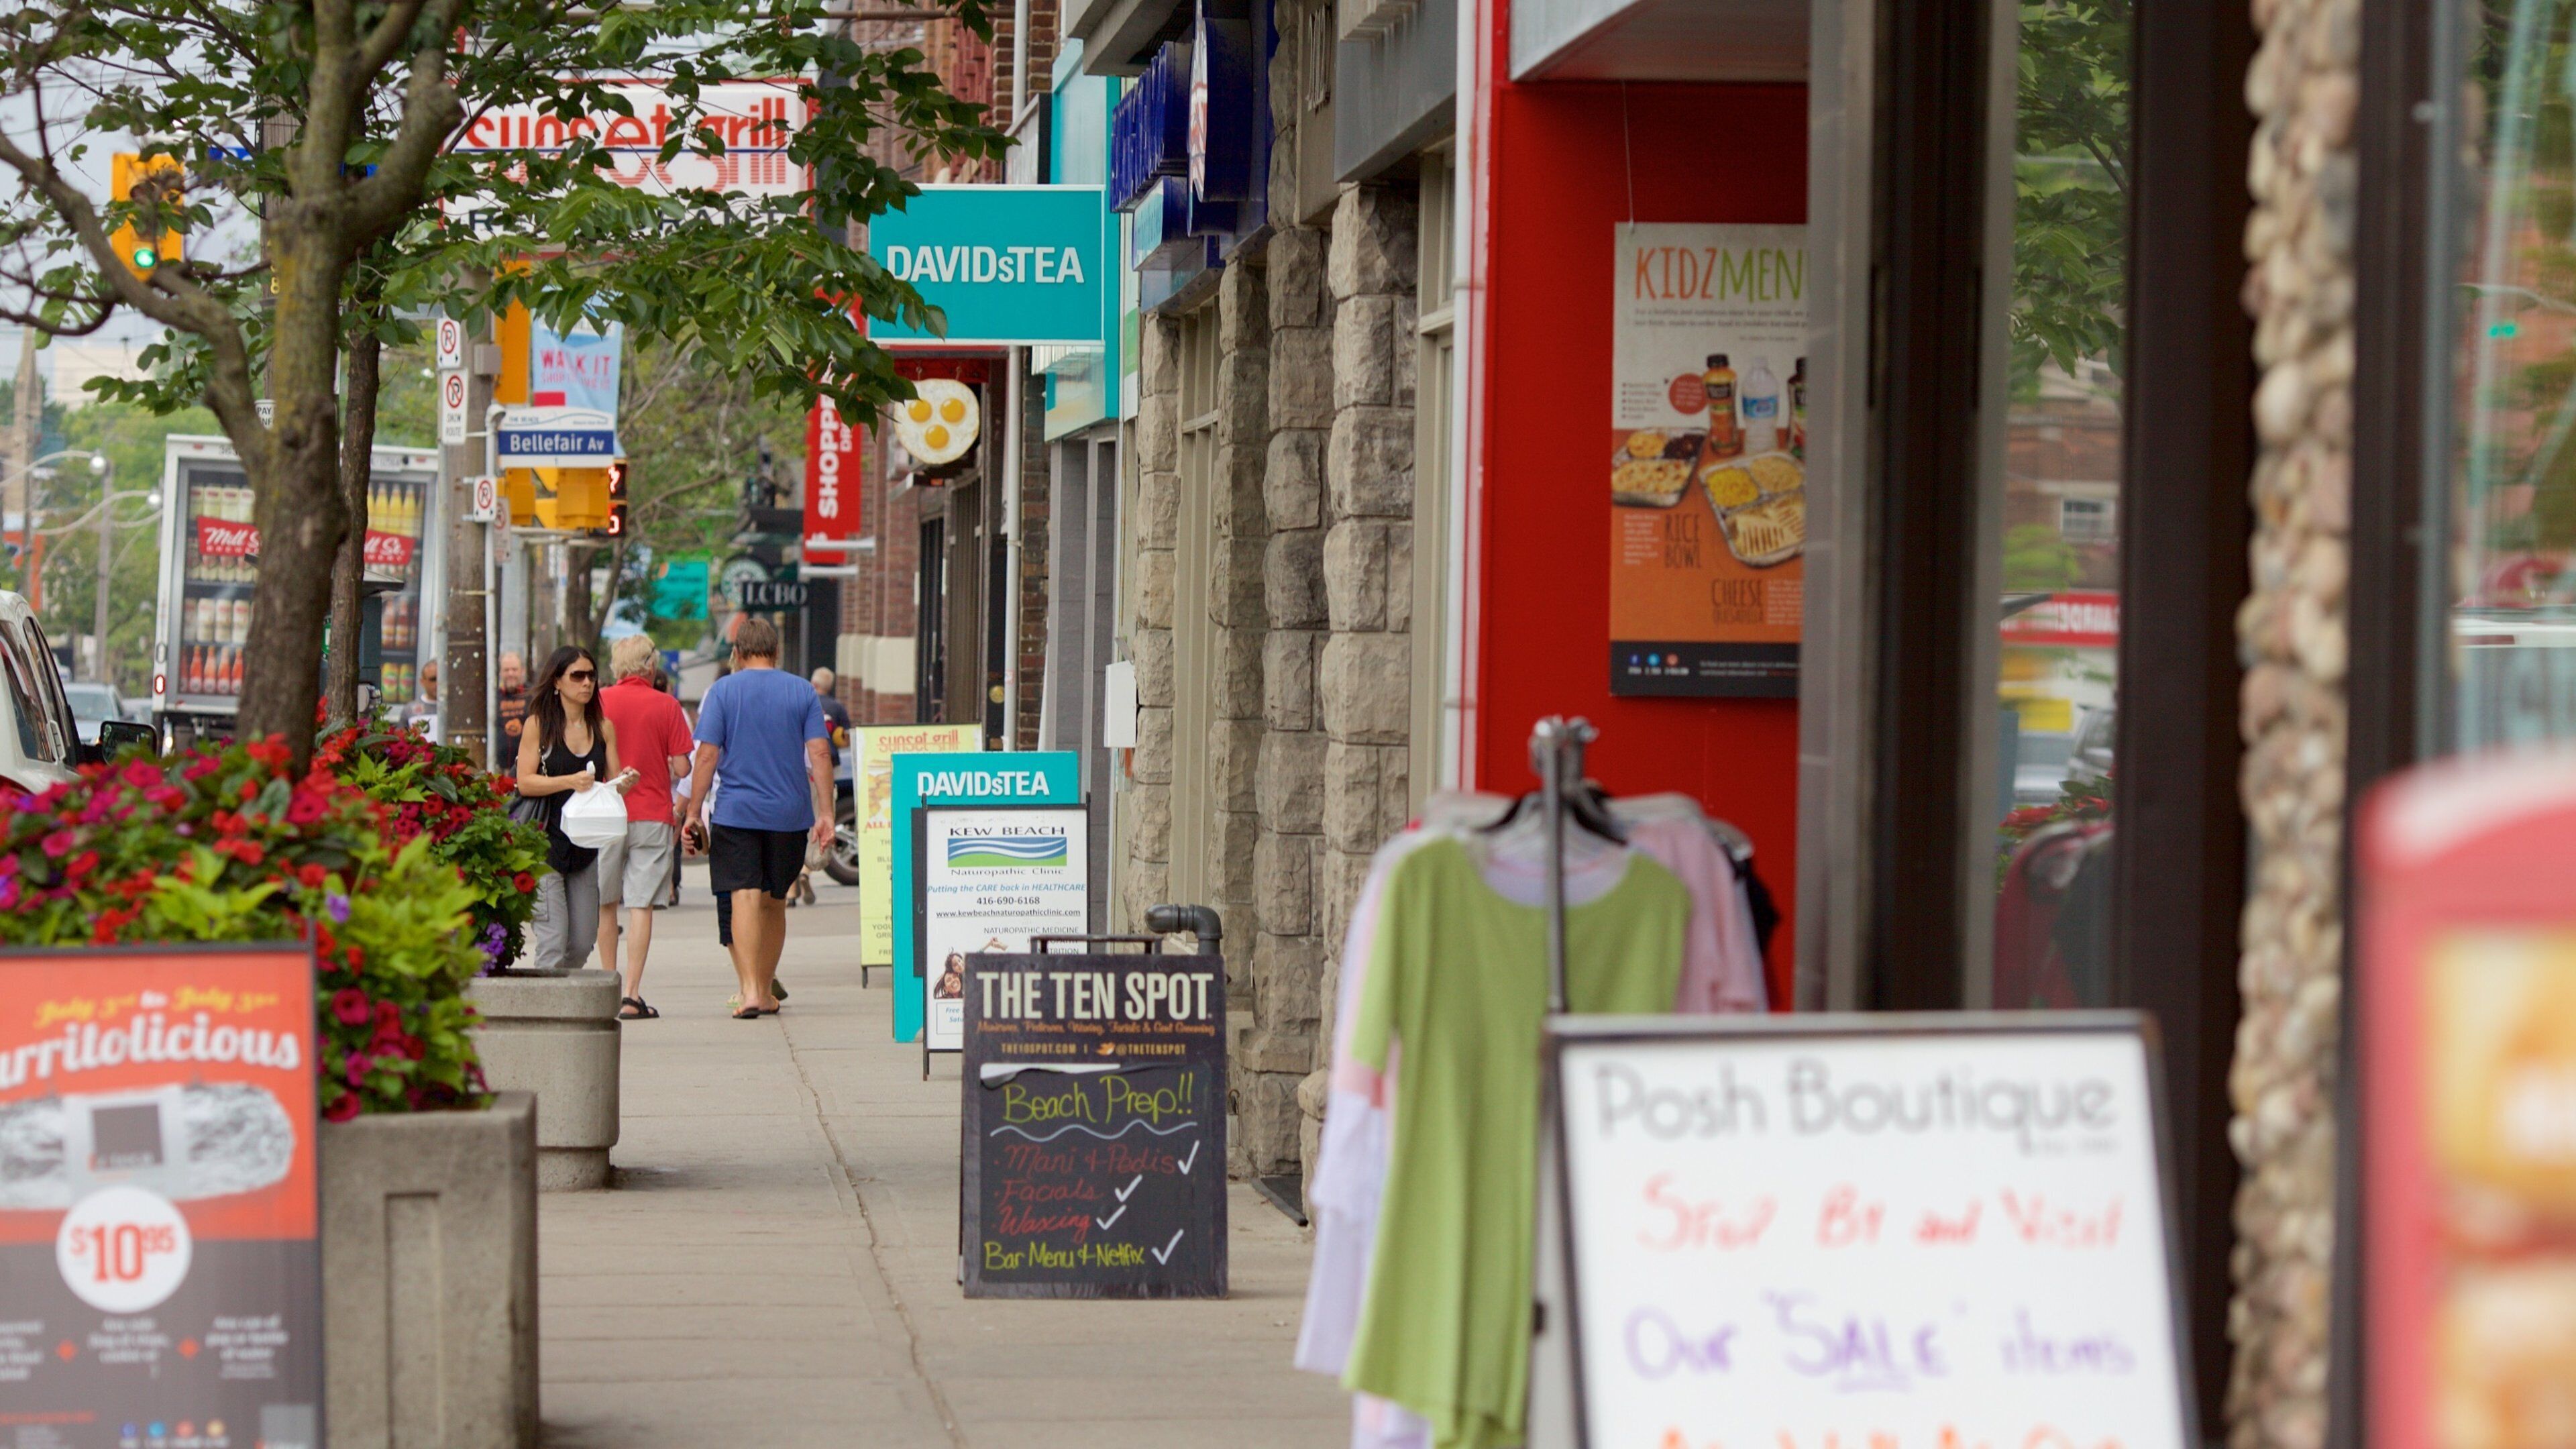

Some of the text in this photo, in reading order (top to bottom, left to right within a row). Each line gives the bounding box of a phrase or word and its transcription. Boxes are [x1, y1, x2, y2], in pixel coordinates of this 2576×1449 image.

[467, 97, 786, 148] sunset grill
[887, 245, 1085, 284] DAVIDsTEA
[257, 407, 272, 415] PAY
[510, 433, 604, 452] Bellefair Av
[818, 366, 839, 519] SHOPPE
[746, 582, 807, 605] LCBO
[879, 729, 959, 746] sunset grill
[917, 771, 1050, 797] DAVIDsTEA
[950, 826, 1065, 837] KEW BEACH
[951, 867, 1064, 877] Naturopathic Clinic
[927, 885, 957, 894] Putting
[960, 884, 973, 892] the
[1000, 883, 1020, 892] back
[1031, 883, 1086, 892] HEALTHCARE
[976, 896, 1040, 905] 416-690-6168
[936, 908, 1081, 918] www.kewbeachnaturopathicclinic.com
[976, 972, 1214, 1020] THE TEN SPOT
[1003, 1071, 1193, 1124] Beach Prep!!
[1594, 1056, 2118, 1156] Posh Boutique
[1004, 1144, 1077, 1178] Mani
[998, 1205, 1092, 1244] Waxing
[983, 1241, 1025, 1271] Bar
[1028, 1240, 1075, 1269] Menu
